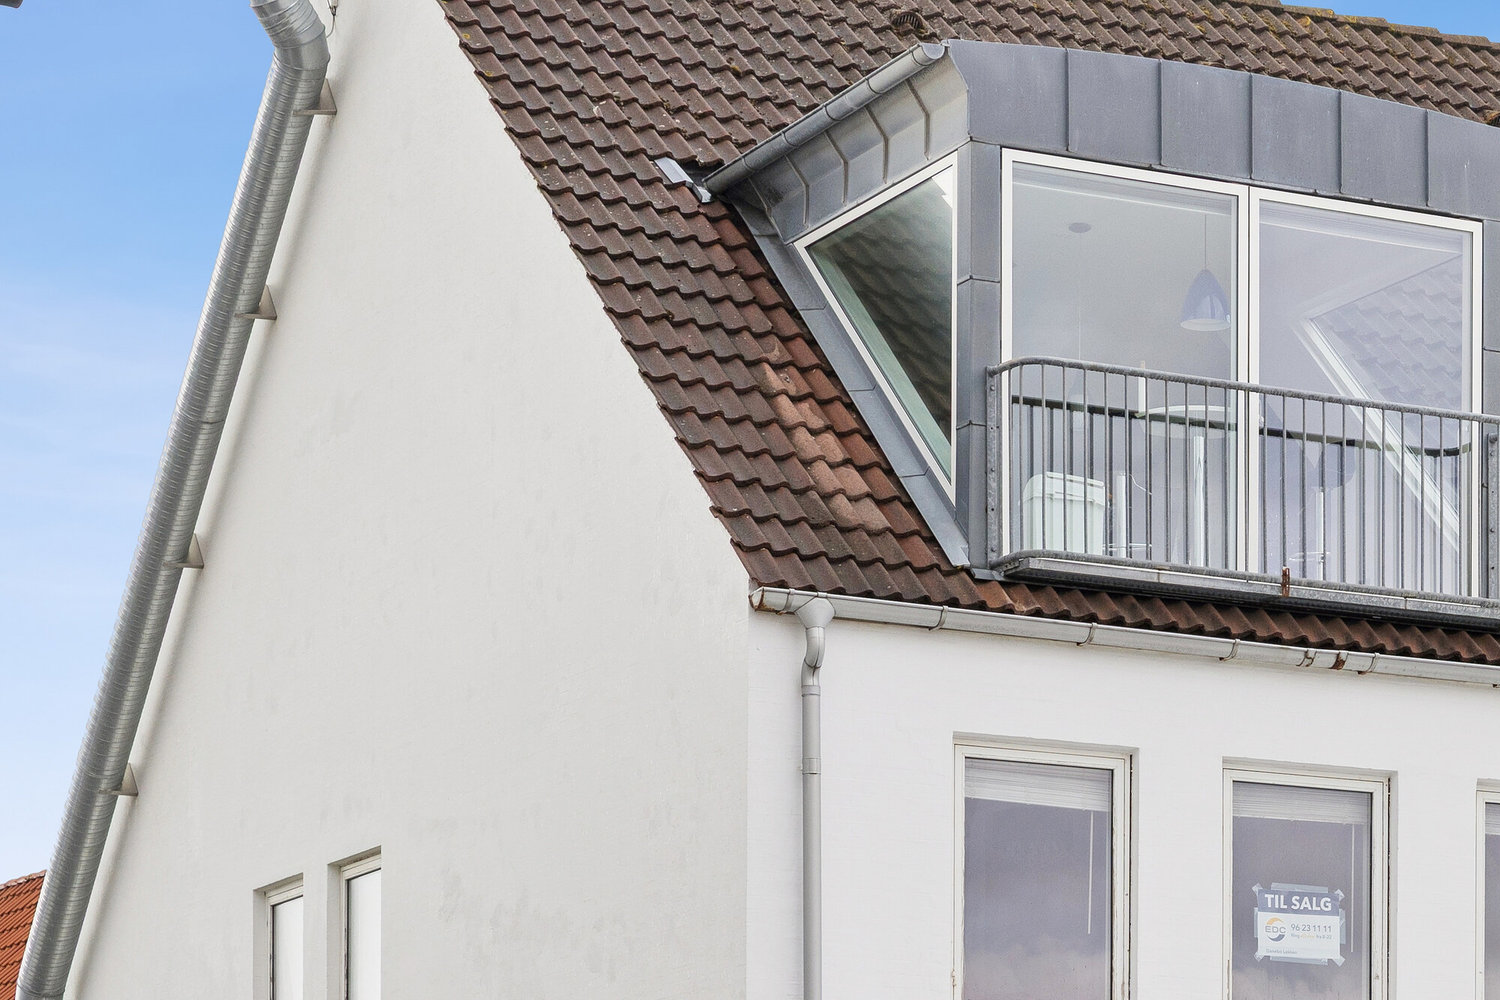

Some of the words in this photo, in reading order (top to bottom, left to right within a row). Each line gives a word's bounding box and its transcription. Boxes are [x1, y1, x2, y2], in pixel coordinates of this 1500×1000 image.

[1265, 894, 1287, 909] TIL
[1291, 896, 1332, 911] SALG
[1265, 926, 1286, 934] EDC
[1290, 923, 1300, 931] 96
[1302, 924, 1311, 932] 23
